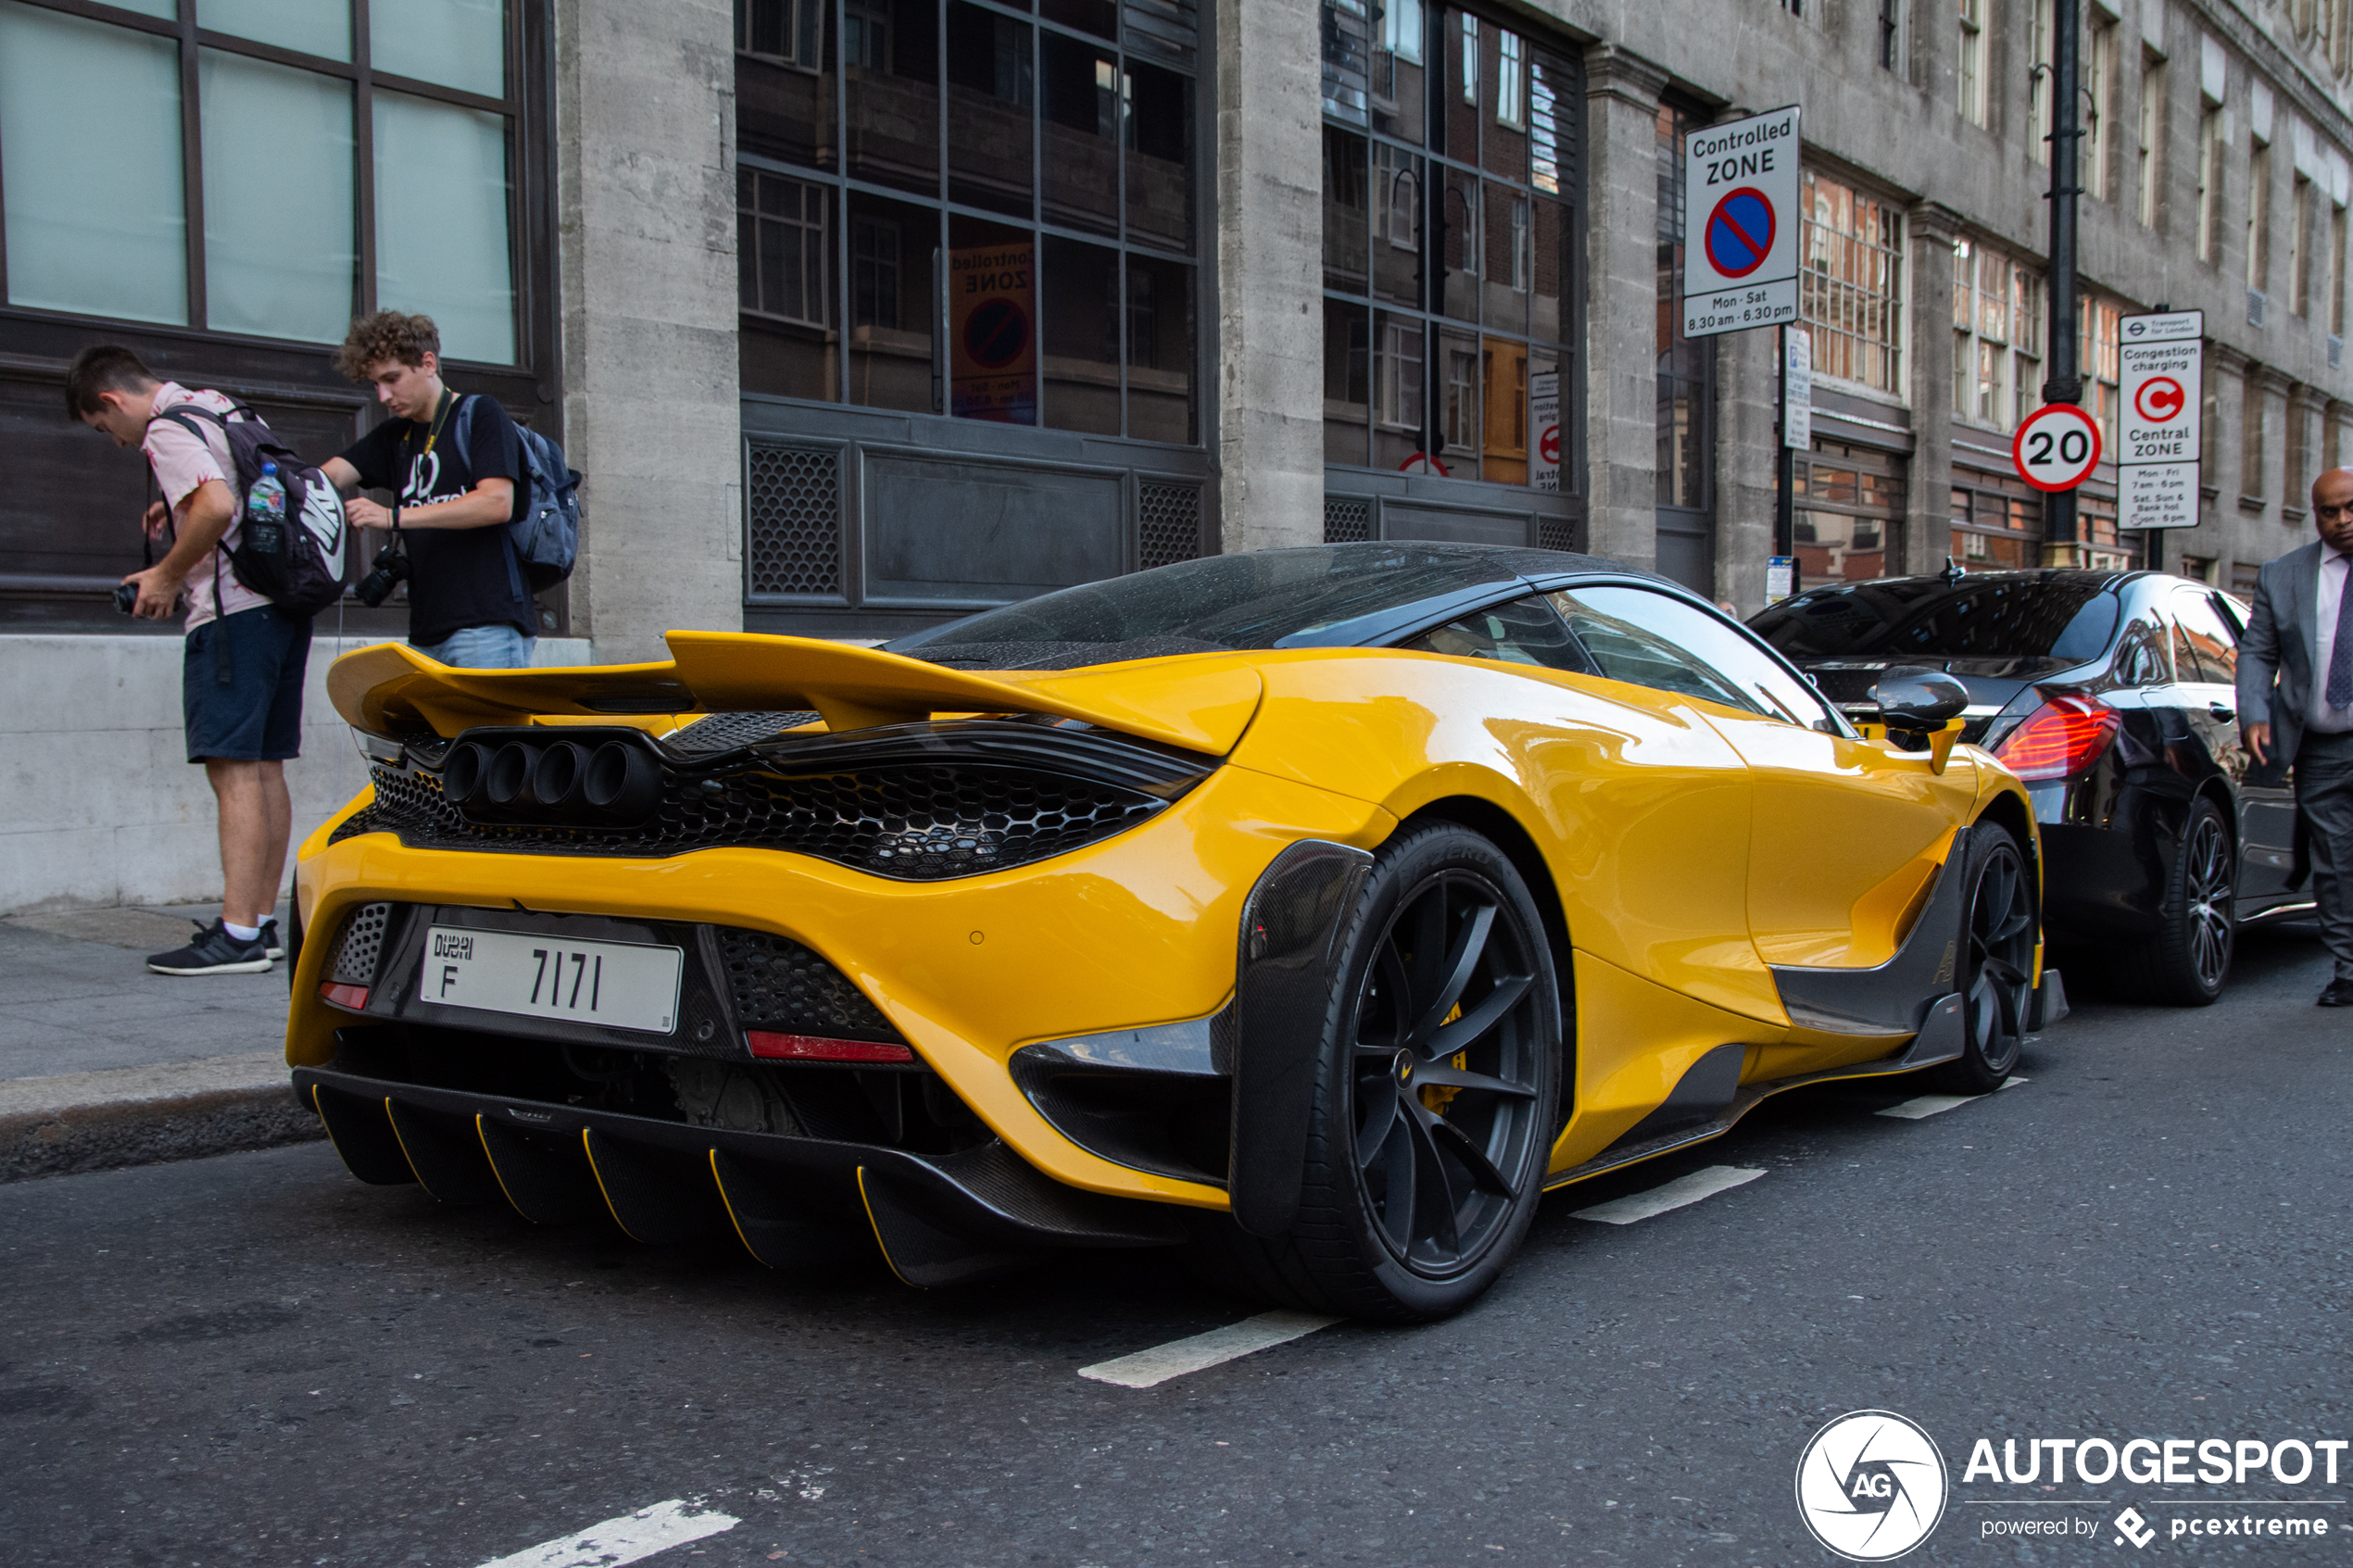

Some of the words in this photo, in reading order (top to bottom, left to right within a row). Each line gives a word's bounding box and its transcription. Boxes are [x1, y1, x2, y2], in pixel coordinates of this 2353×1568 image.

[1693, 117, 1792, 157] Controlled
[1707, 148, 1775, 185] ZONE
[1713, 297, 1738, 310] Mon
[1746, 290, 1768, 305] Sat
[1688, 316, 1715, 331] 8.30
[1718, 313, 1734, 325] am
[1743, 306, 1771, 322] 6.30
[1774, 304, 1793, 318] pm
[2151, 319, 2190, 327] Transport
[2151, 327, 2163, 335] for
[2166, 325, 2195, 334] London
[2124, 346, 2197, 361] Congestion
[2132, 358, 2188, 372] charging
[2130, 427, 2189, 442] Central
[2029, 430, 2088, 466] 20
[2134, 443, 2183, 457] ZONE
[2137, 470, 2158, 478] Mon
[2166, 469, 2180, 477] Fri
[2169, 481, 2184, 489] pm
[2155, 494, 2174, 502] Sun
[2137, 504, 2160, 512] Bank
[2171, 514, 2186, 522] pm
[441, 965, 459, 998] F
[530, 948, 603, 1011] 7171
